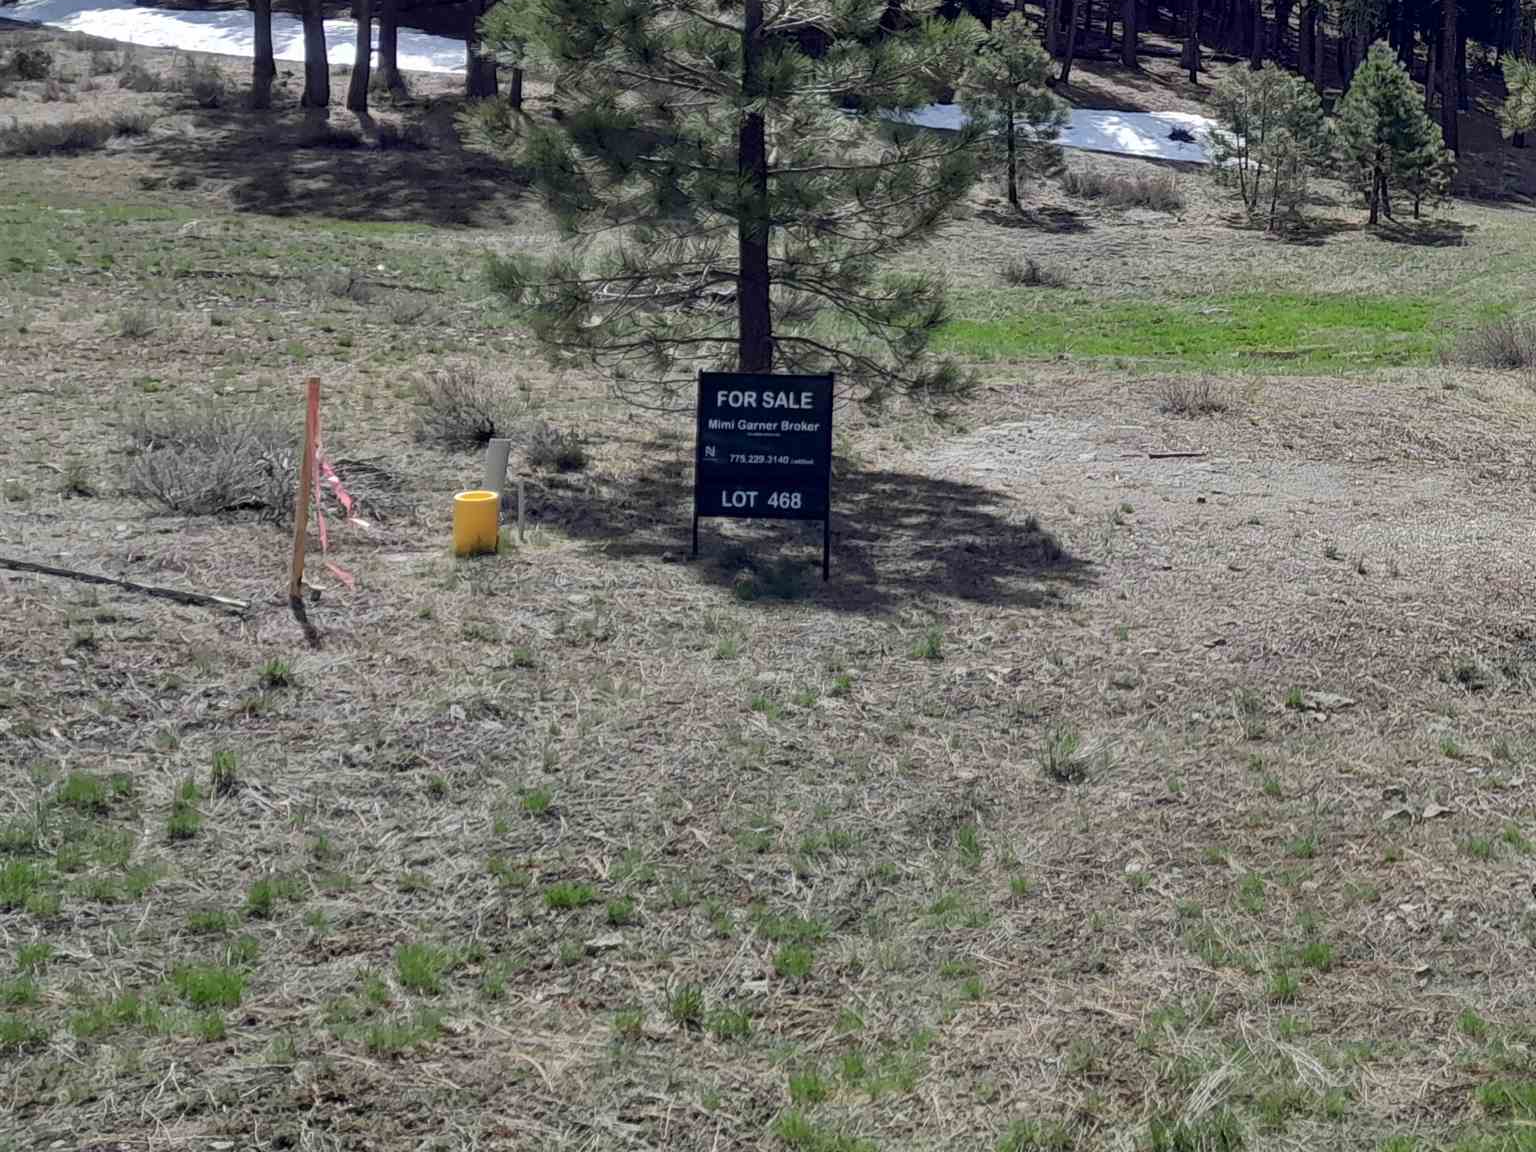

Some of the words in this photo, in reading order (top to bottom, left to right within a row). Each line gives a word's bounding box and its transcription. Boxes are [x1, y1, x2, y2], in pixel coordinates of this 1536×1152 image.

[717, 391, 756, 408] FOR
[762, 392, 813, 409] SALE
[708, 419, 735, 430] Mimi
[737, 419, 778, 431] Garner
[781, 420, 820, 432] Broker
[721, 491, 758, 508] LOT
[767, 492, 801, 509] 468
